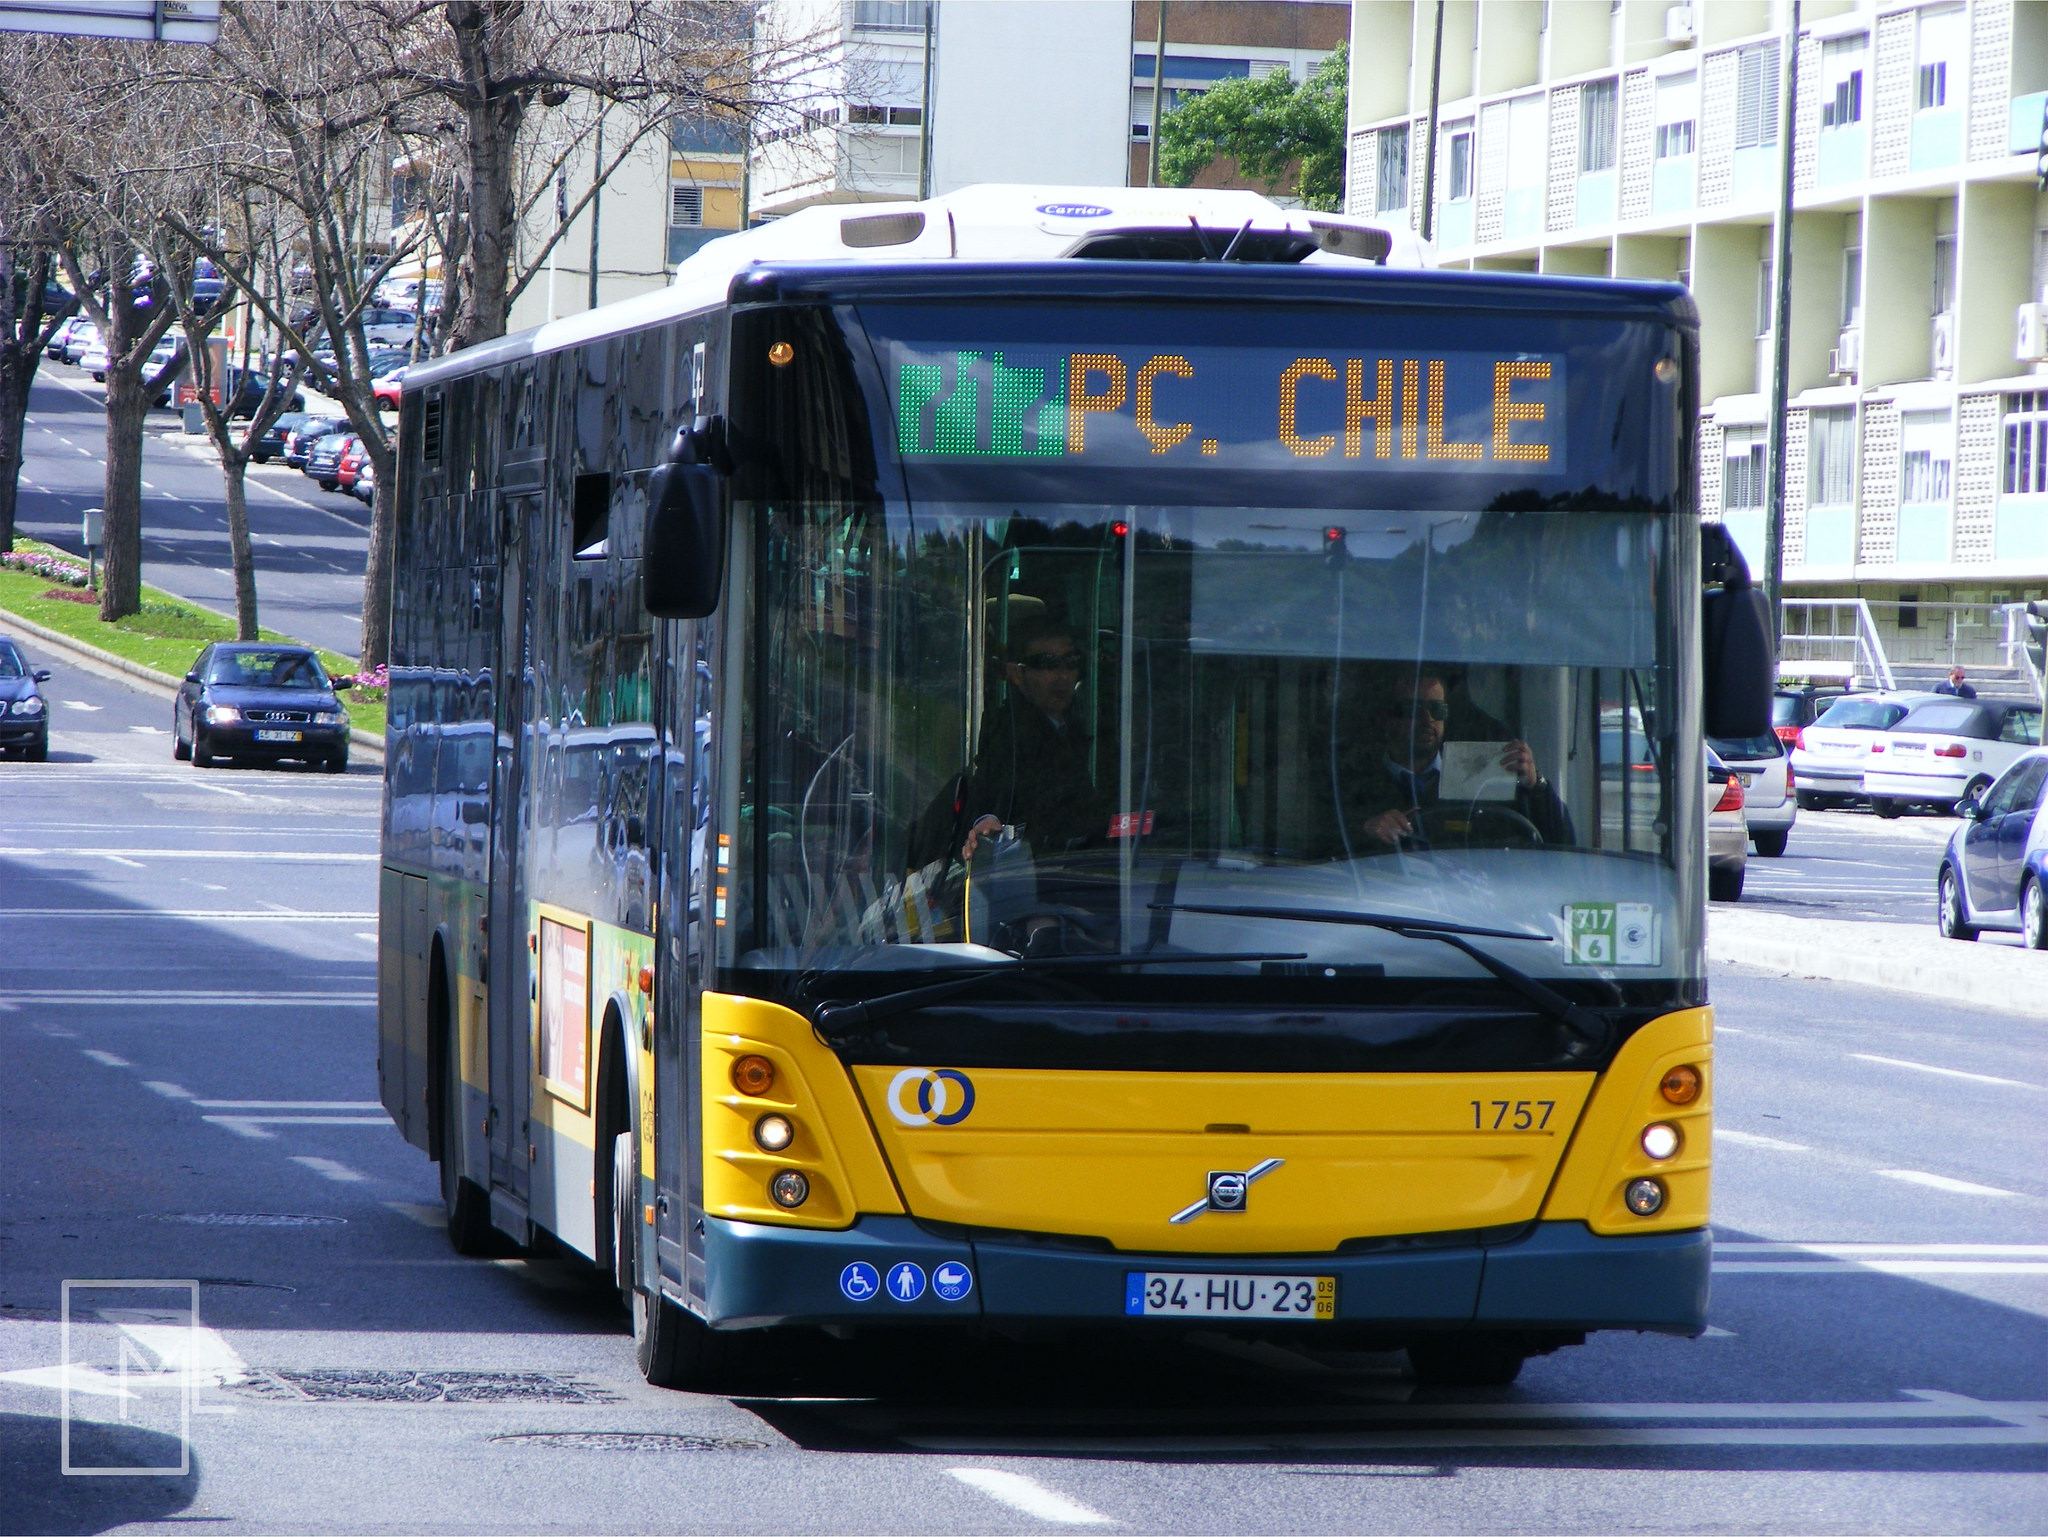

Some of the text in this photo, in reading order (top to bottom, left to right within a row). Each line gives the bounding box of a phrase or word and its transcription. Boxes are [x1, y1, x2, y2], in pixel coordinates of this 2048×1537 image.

[1044, 204, 1105, 216] Carrier
[1068, 352, 1219, 457] PÇ.
[1279, 356, 1552, 463] CHILE
[1575, 908, 1614, 930] 717
[1587, 939, 1602, 958] 6
[1470, 1100, 1557, 1130] 1757
[1317, 1281, 1335, 1293] 09
[1131, 1298, 1140, 1307] P
[1316, 1301, 1333, 1313] 06
